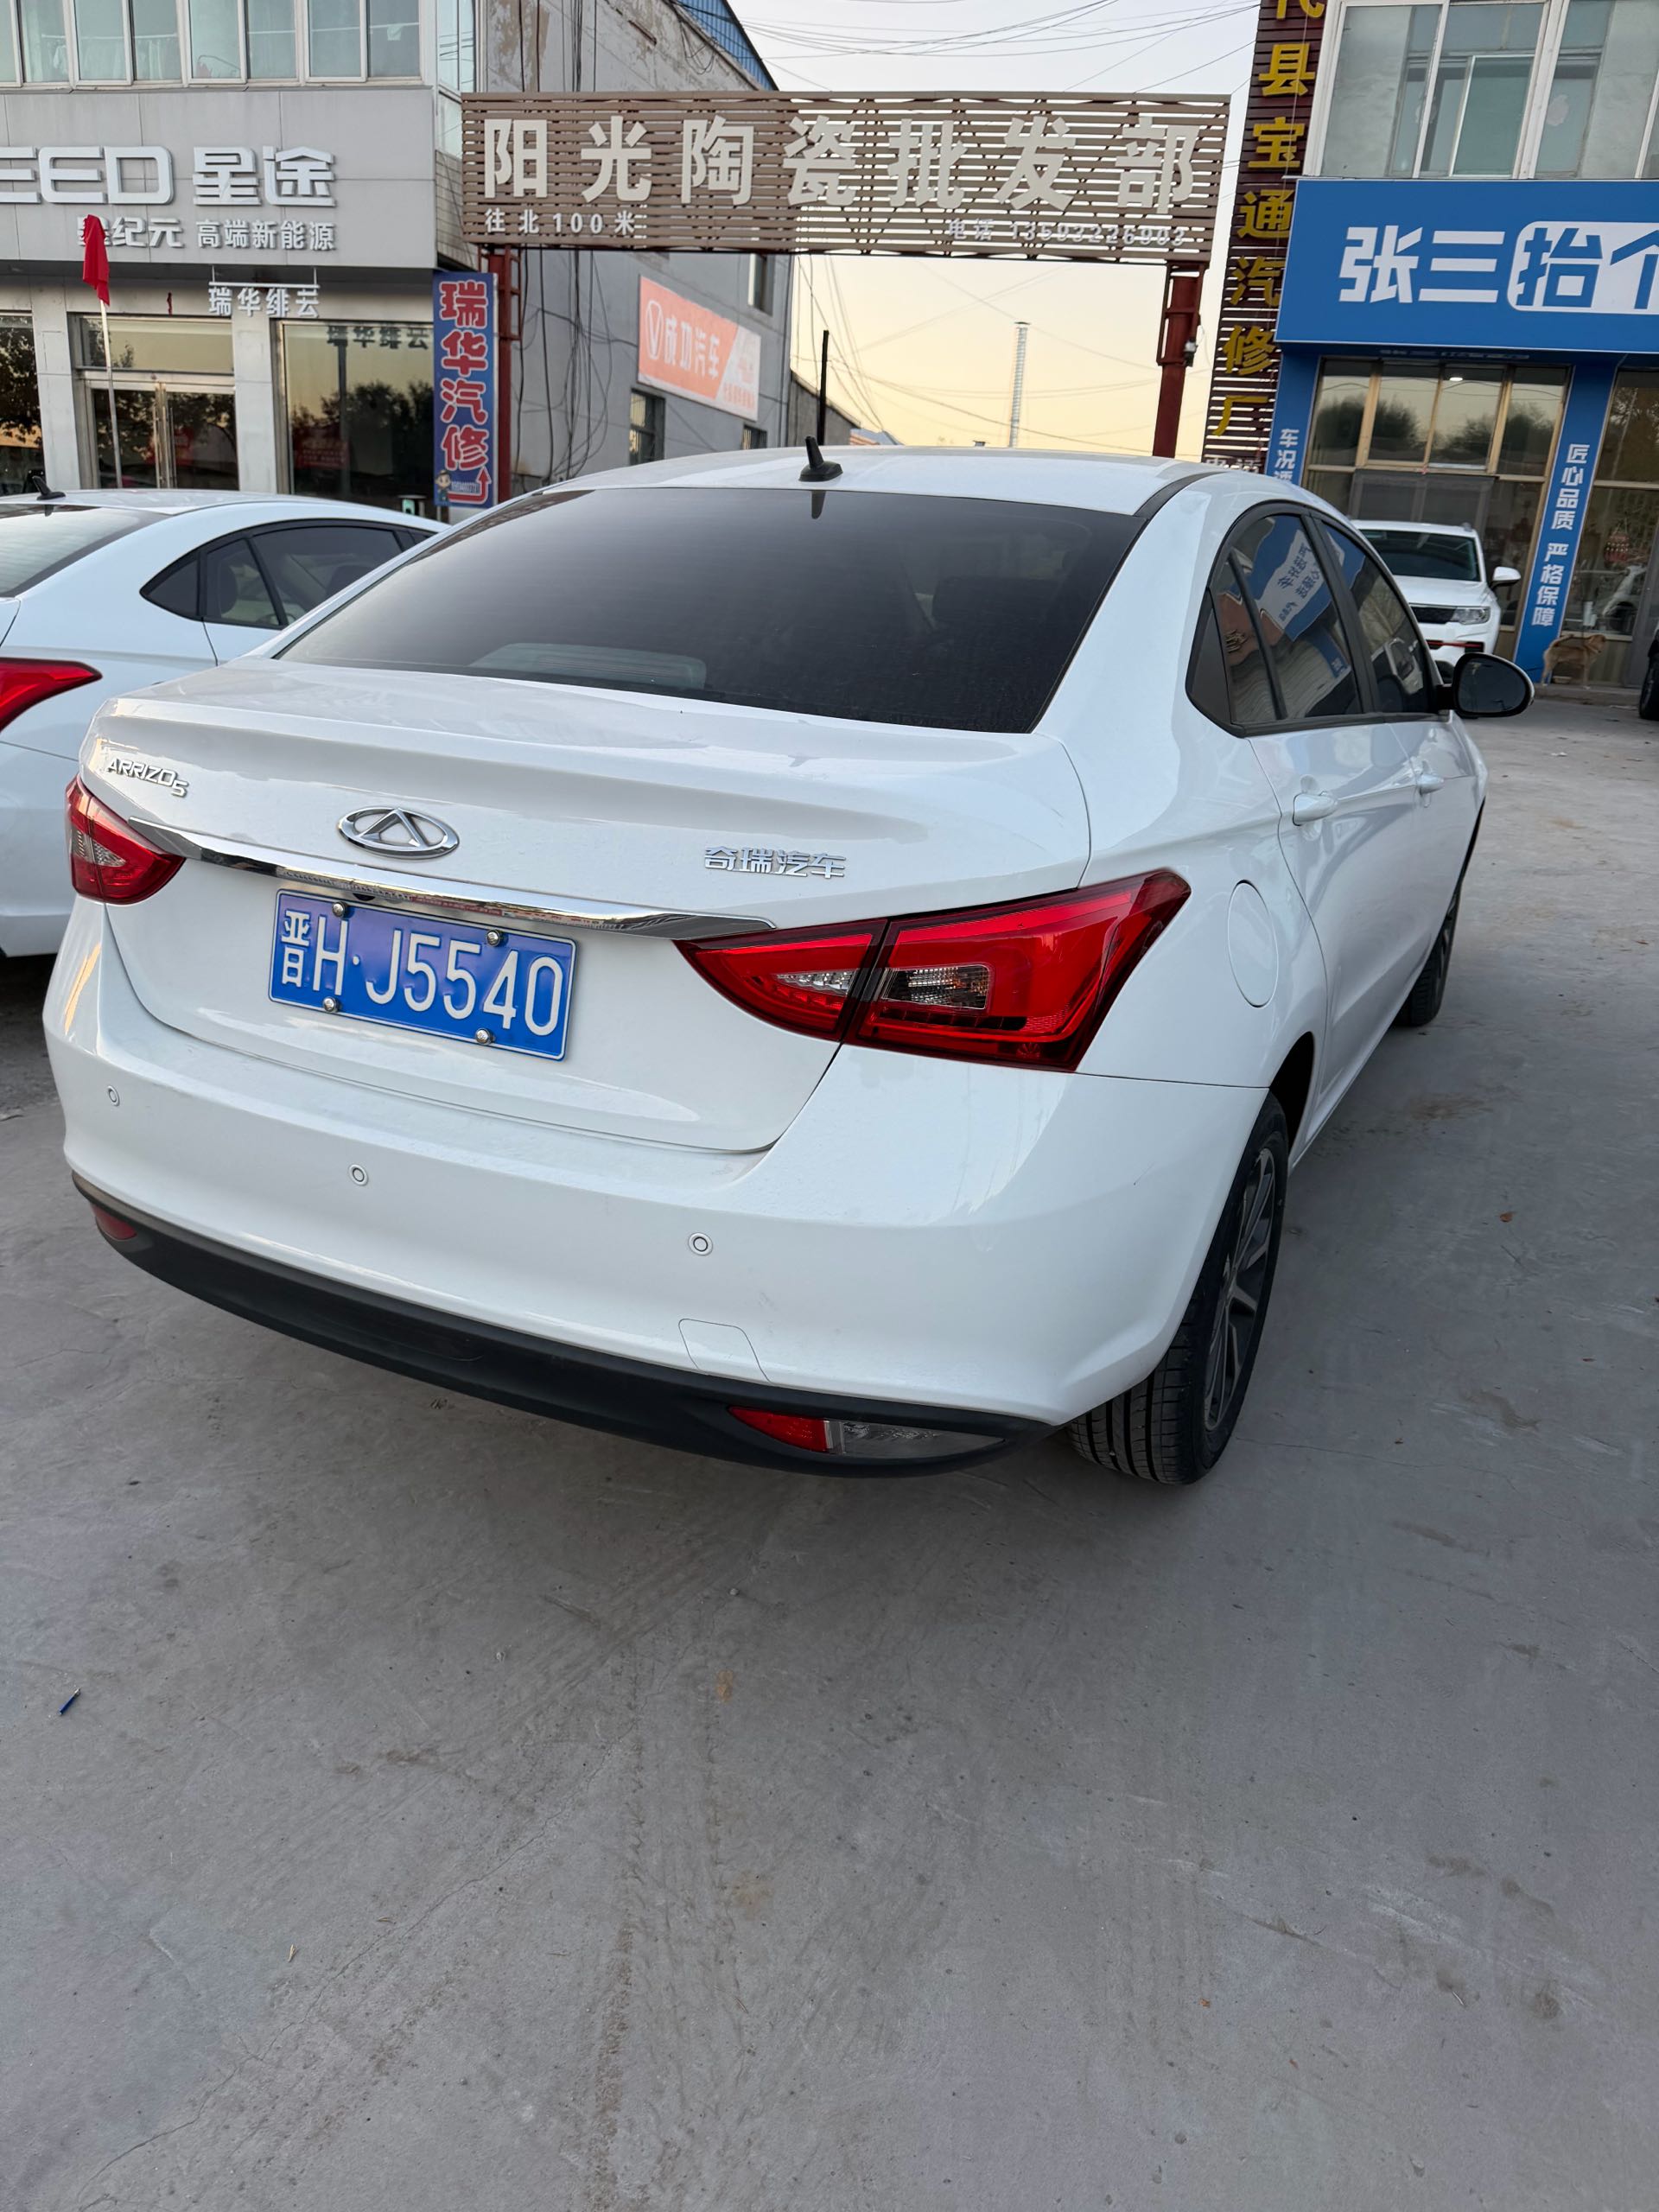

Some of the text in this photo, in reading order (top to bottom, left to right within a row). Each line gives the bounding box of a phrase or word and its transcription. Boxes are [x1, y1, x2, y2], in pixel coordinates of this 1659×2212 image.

[193, 145, 337, 207] 星途
[483, 114, 1200, 214] 阳光陶瓷批发部
[195, 218, 337, 251] 高端新能源
[949, 218, 995, 242] 电话
[438, 279, 490, 472] 瑞华汽修
[1530, 442, 1591, 627] 匠心品质 严格保障
[703, 846, 847, 880] 奇瑞汽车
